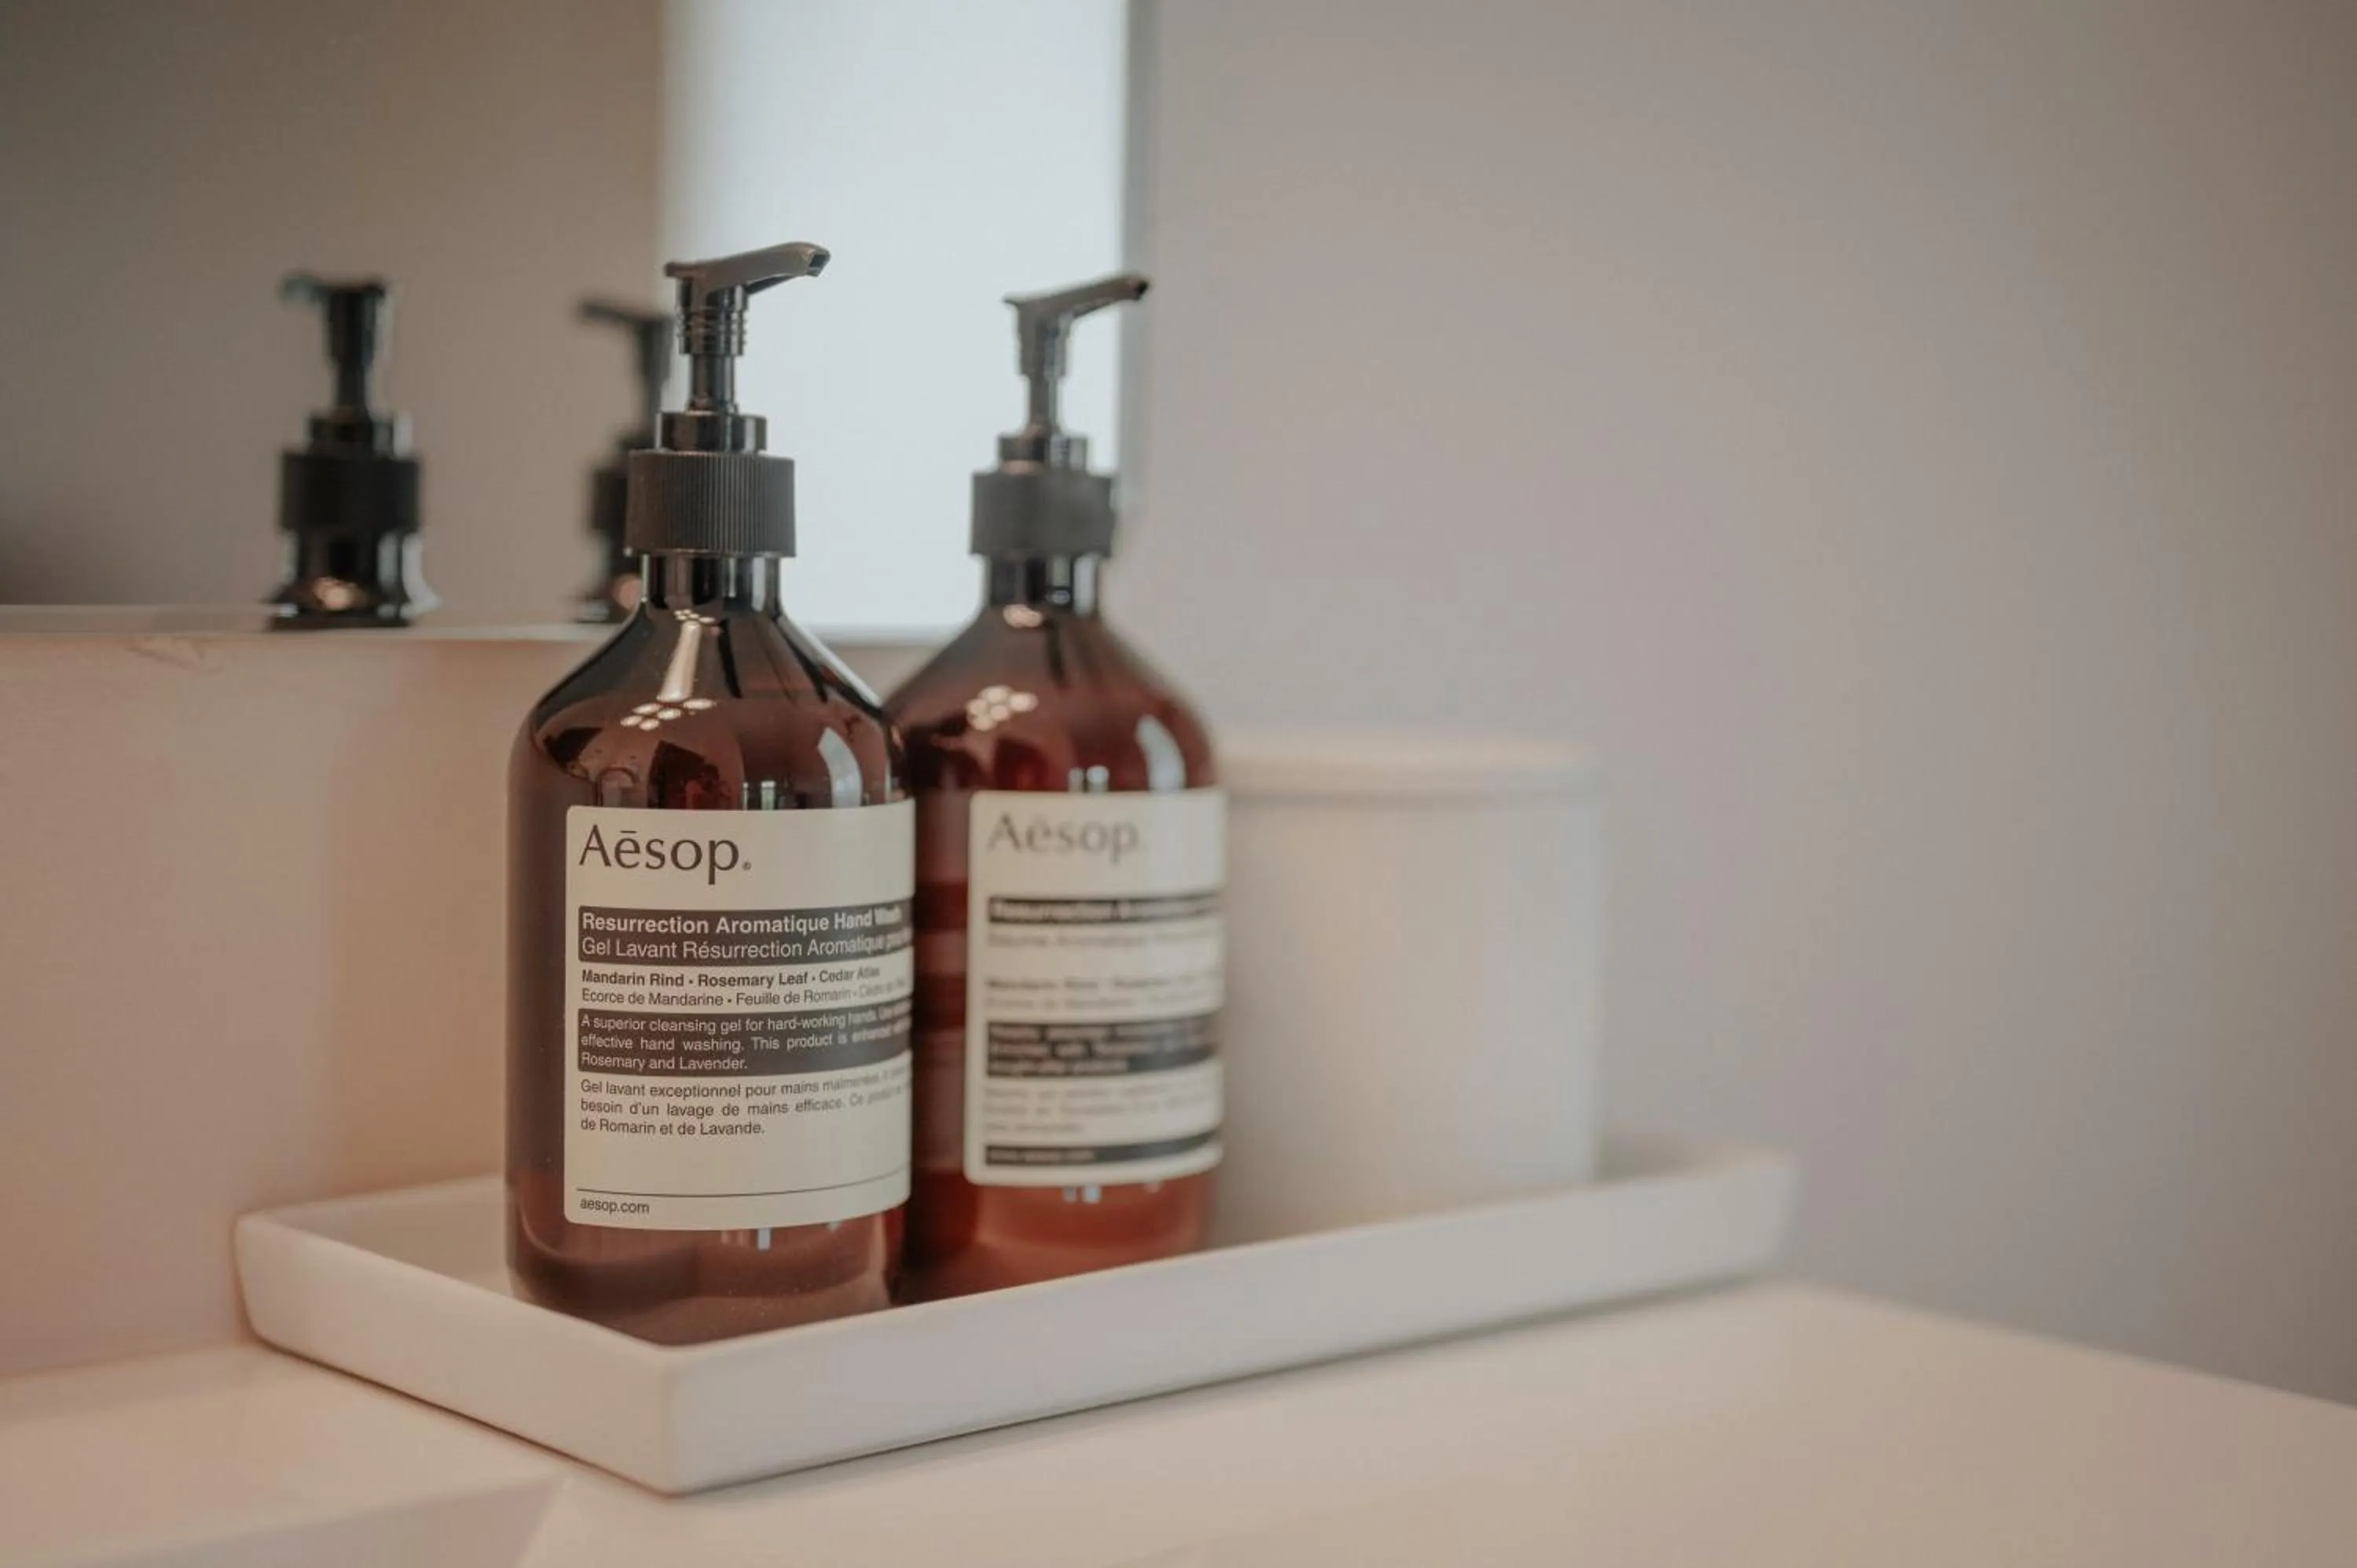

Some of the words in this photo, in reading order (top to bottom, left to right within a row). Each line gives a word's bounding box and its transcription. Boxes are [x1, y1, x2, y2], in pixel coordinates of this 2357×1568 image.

[582, 912, 709, 934] Resurrection
[715, 915, 830, 936] Aromatique
[834, 908, 873, 930] Hand
[582, 937, 610, 956] Gel
[616, 938, 678, 958] Lavant
[683, 940, 802, 959] Résurrection
[581, 969, 645, 986] Mandarin
[650, 973, 684, 987] Rind
[698, 973, 774, 990] Rosemary
[779, 971, 808, 985] Leaf
[819, 967, 854, 983] Cedar
[581, 987, 625, 1003] Ecorce
[628, 991, 645, 1005] de
[648, 992, 724, 1006] Mandarine
[736, 992, 780, 1006] Feuille
[783, 990, 801, 1005] de
[581, 1014, 590, 1026] A
[593, 1017, 646, 1031] superior
[649, 1019, 717, 1035] cleansing
[720, 1019, 742, 1035] gel
[746, 1018, 764, 1031] for
[768, 1010, 846, 1031] hard-working
[581, 1033, 633, 1049] effective
[640, 1036, 675, 1050] hand
[682, 1037, 745, 1053] washing.
[751, 1036, 780, 1050] This
[786, 1032, 833, 1051] product
[581, 1052, 645, 1072] Rosemary
[648, 1057, 675, 1069] and
[680, 1057, 748, 1070] Lavender.
[580, 1079, 603, 1093] Gel
[606, 1081, 645, 1095] lavant
[650, 1083, 741, 1100] exceptionnel
[746, 1084, 777, 1099] pour
[780, 1080, 819, 1094] mains
[581, 1099, 623, 1112] besoin
[629, 1102, 659, 1115] d'un
[667, 1104, 714, 1119] lavage
[722, 1103, 739, 1116] de
[747, 1100, 789, 1115] mains
[581, 1119, 596, 1130] de
[599, 1119, 655, 1134] Romarin
[659, 1122, 673, 1134] et
[677, 1120, 695, 1134] de
[700, 1121, 764, 1135] Lavande.
[580, 1199, 650, 1214] aesop.com
